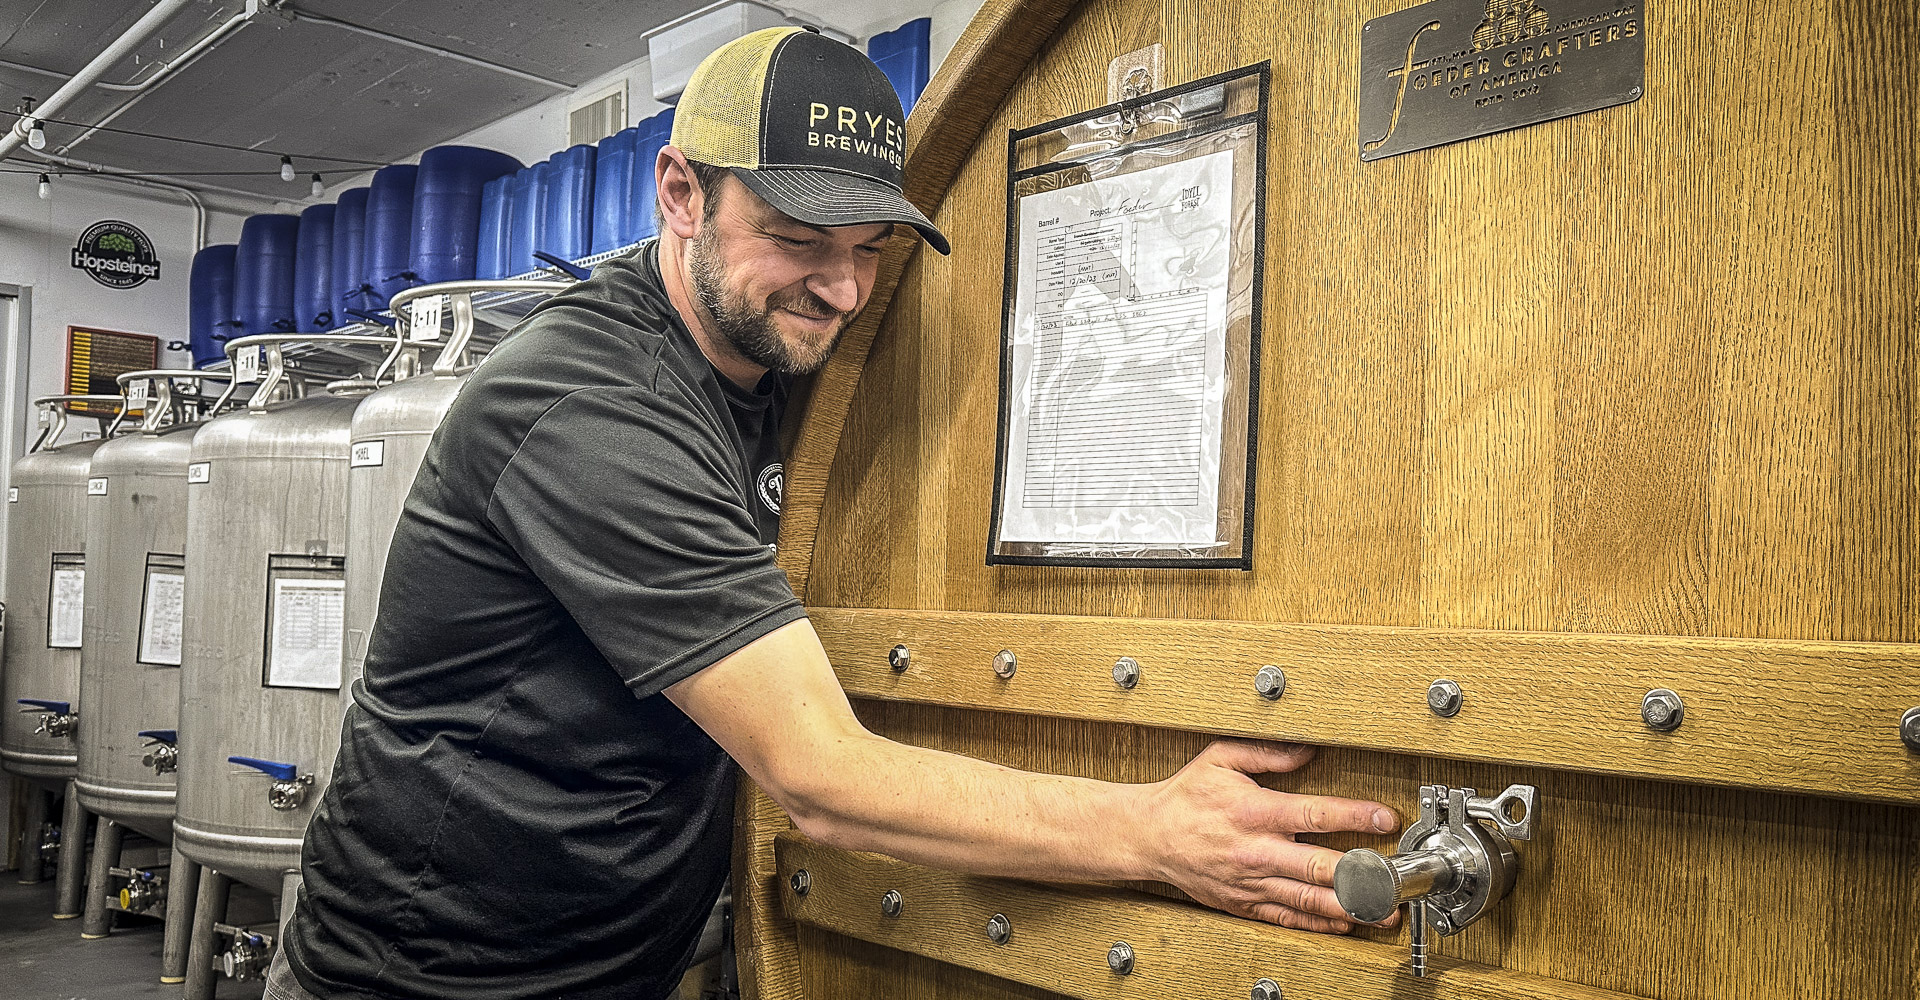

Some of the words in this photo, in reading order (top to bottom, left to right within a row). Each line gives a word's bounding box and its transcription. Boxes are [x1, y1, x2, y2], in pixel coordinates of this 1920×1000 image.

[1554, 11, 1610, 33] AMERICAN
[1502, 19, 1639, 68] CRAFTERS
[1449, 83, 1471, 99] OF
[1480, 61, 1562, 92] AMERICA
[809, 101, 903, 152] PRYES
[807, 131, 895, 165] BREWING
[1038, 219, 1055, 228] Barrel
[1089, 207, 1112, 217] Project:
[74, 251, 158, 277] Hopsteiner
[414, 309, 437, 328] 2-11
